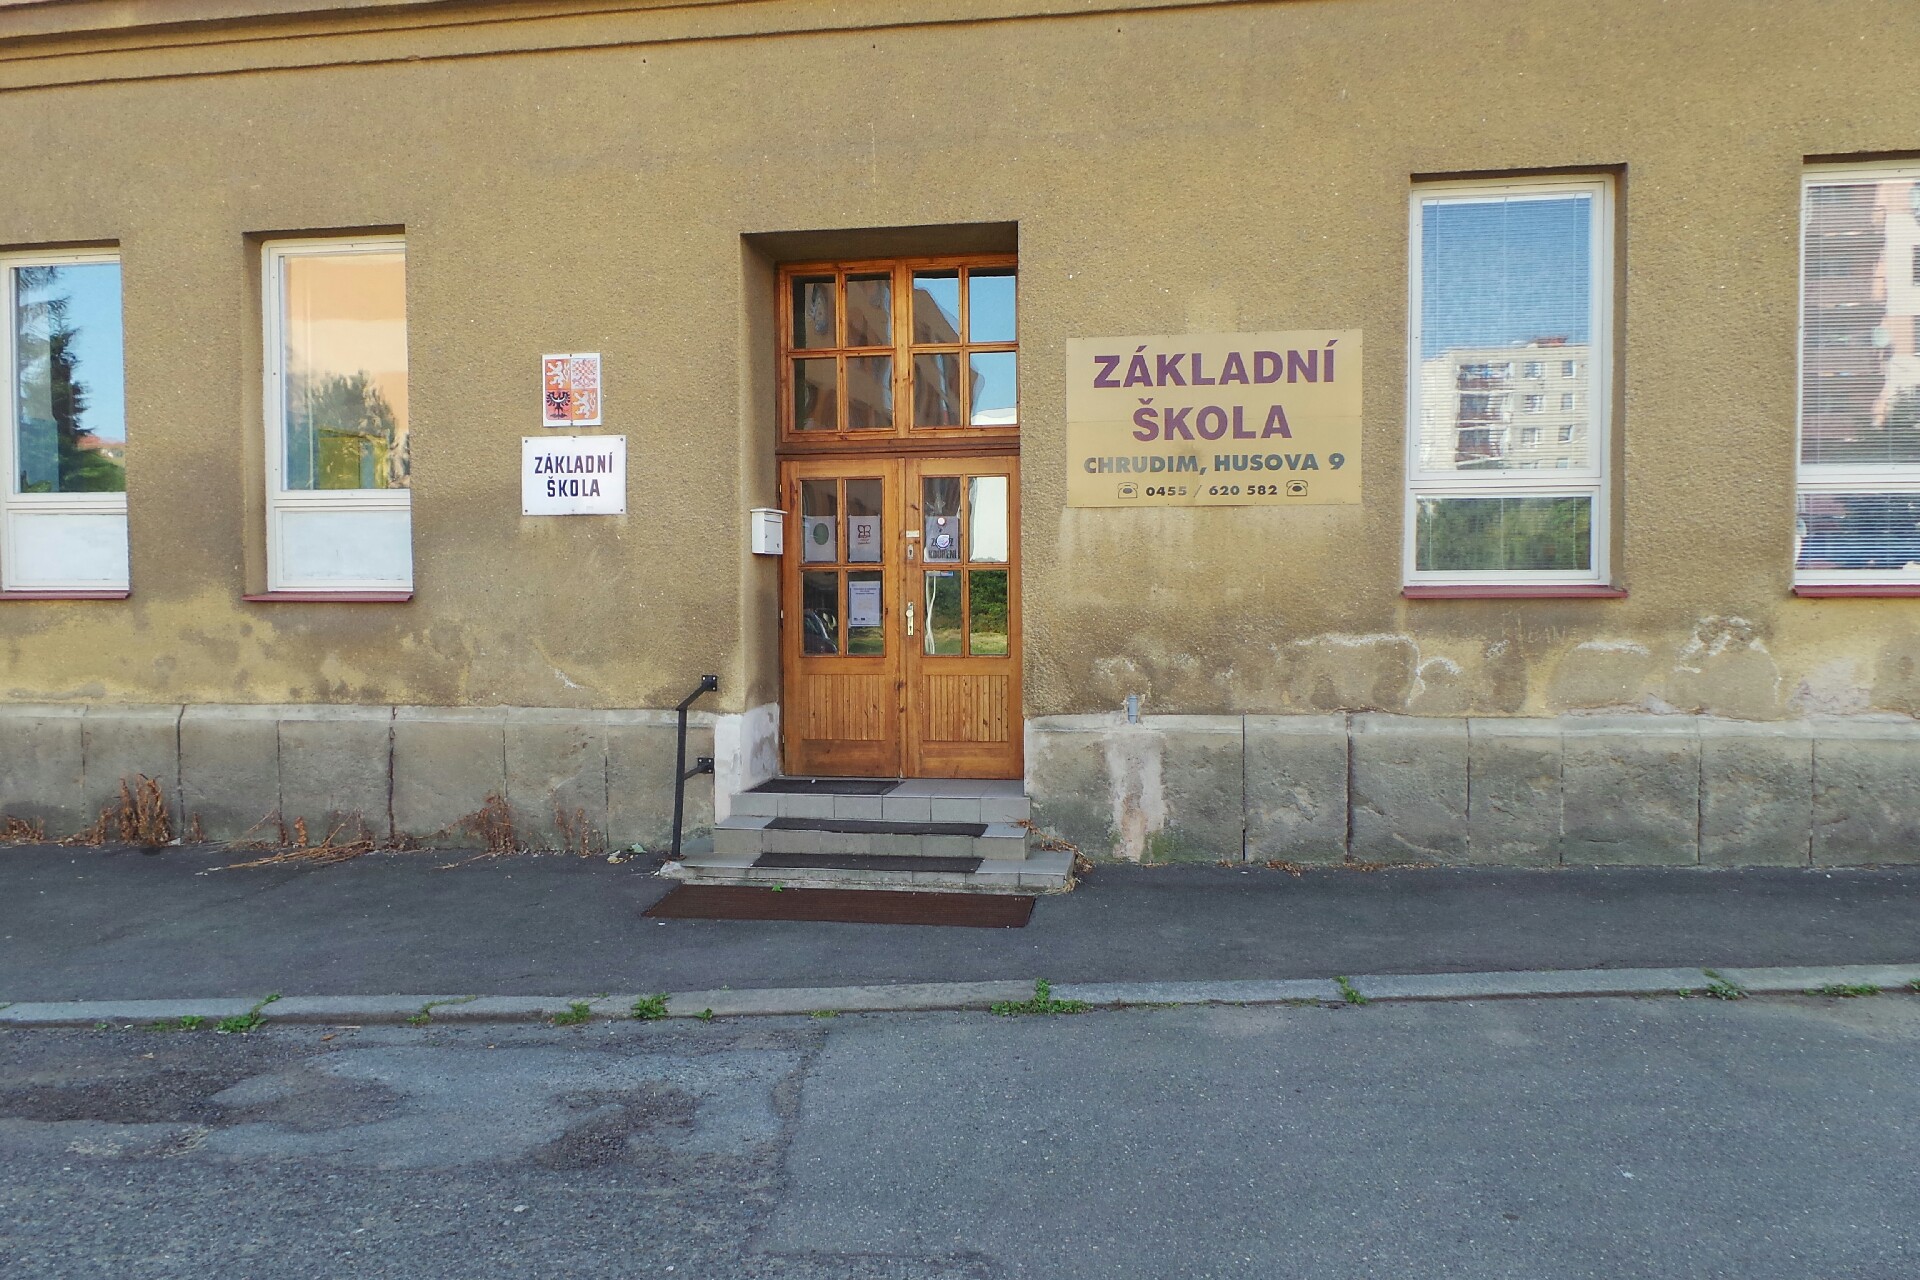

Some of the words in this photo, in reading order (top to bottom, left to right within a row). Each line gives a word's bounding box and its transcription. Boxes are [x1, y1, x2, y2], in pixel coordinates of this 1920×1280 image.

[1093, 339, 1338, 389] ZÁKLADNÍ
[1132, 398, 1293, 442] ŠKOLA
[534, 452, 613, 474] ZÁKLADNÍ
[1083, 455, 1207, 475] CHRUDIM,
[1214, 453, 1319, 472] HUSOVA
[1328, 453, 1345, 470] 9
[547, 476, 600, 497] ŠKOLA
[1145, 486, 1188, 497] 0455
[1209, 485, 1240, 496] 620
[1246, 484, 1278, 496] 582
